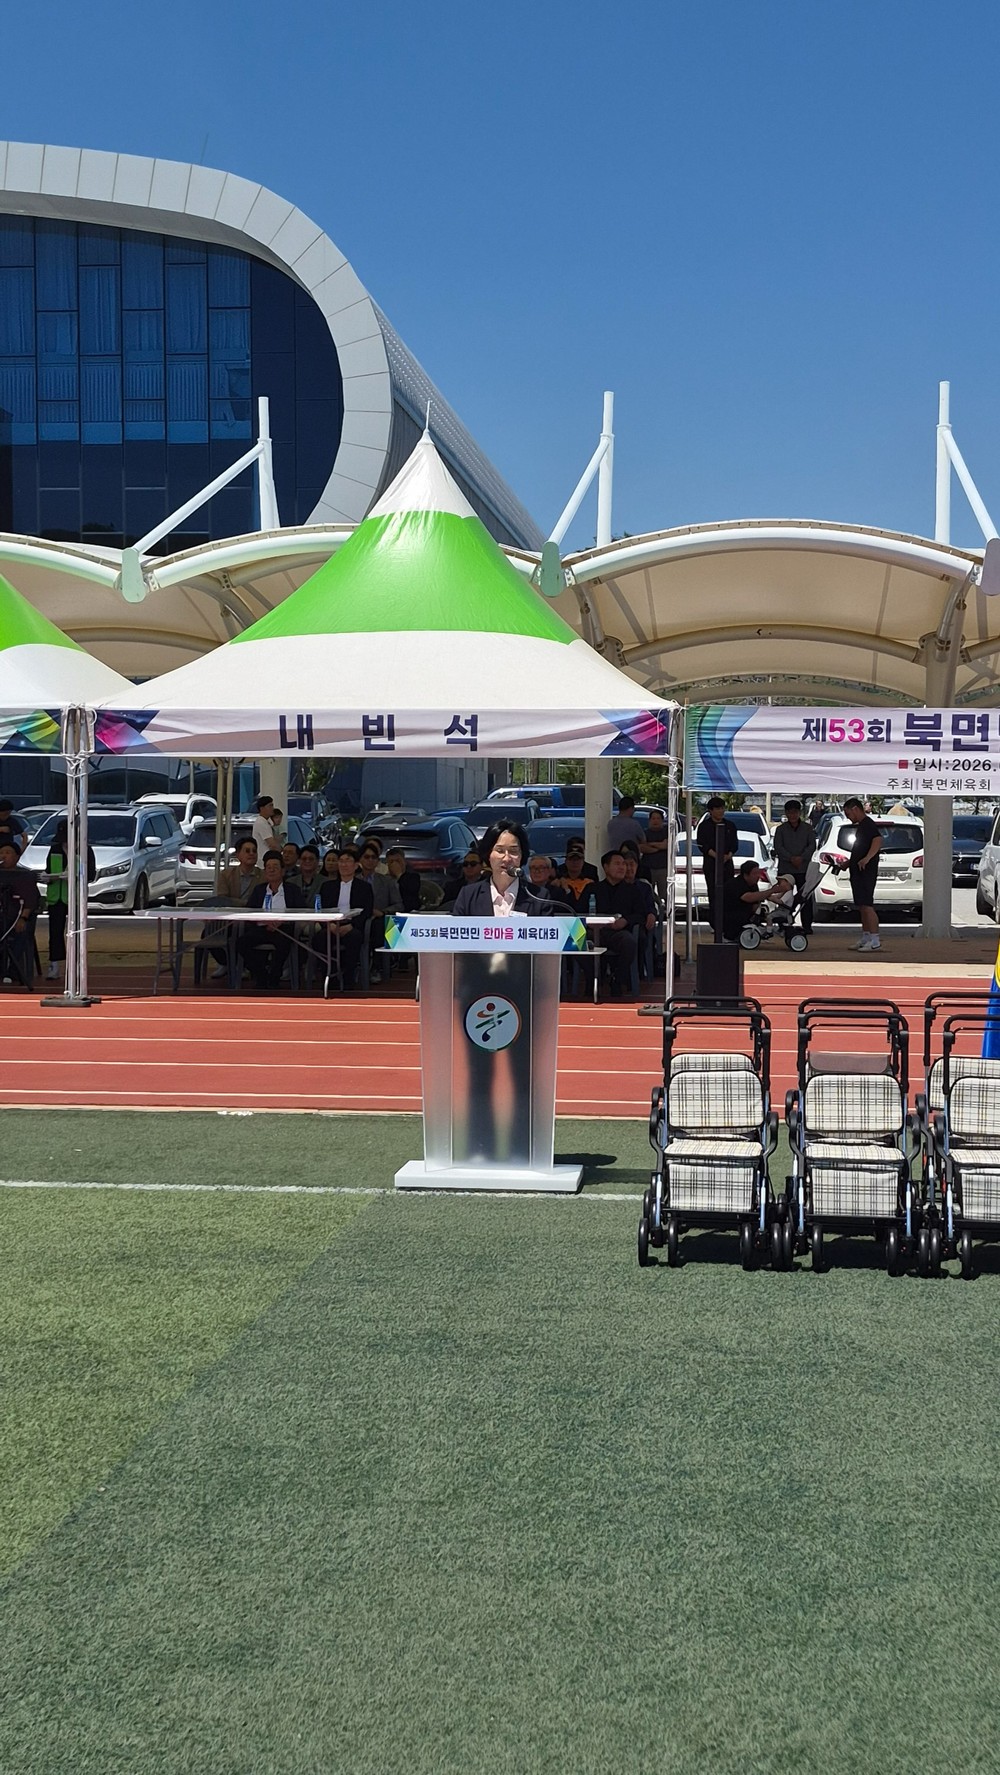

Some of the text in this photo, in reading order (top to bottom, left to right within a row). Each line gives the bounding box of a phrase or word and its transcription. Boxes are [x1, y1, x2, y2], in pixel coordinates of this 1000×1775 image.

[801, 713, 1000, 751] 제53회 북면
[913, 757, 1000, 773] 일시:2026.
[483, 927, 514, 940] 한마음
[517, 927, 559, 940] 체육대회
